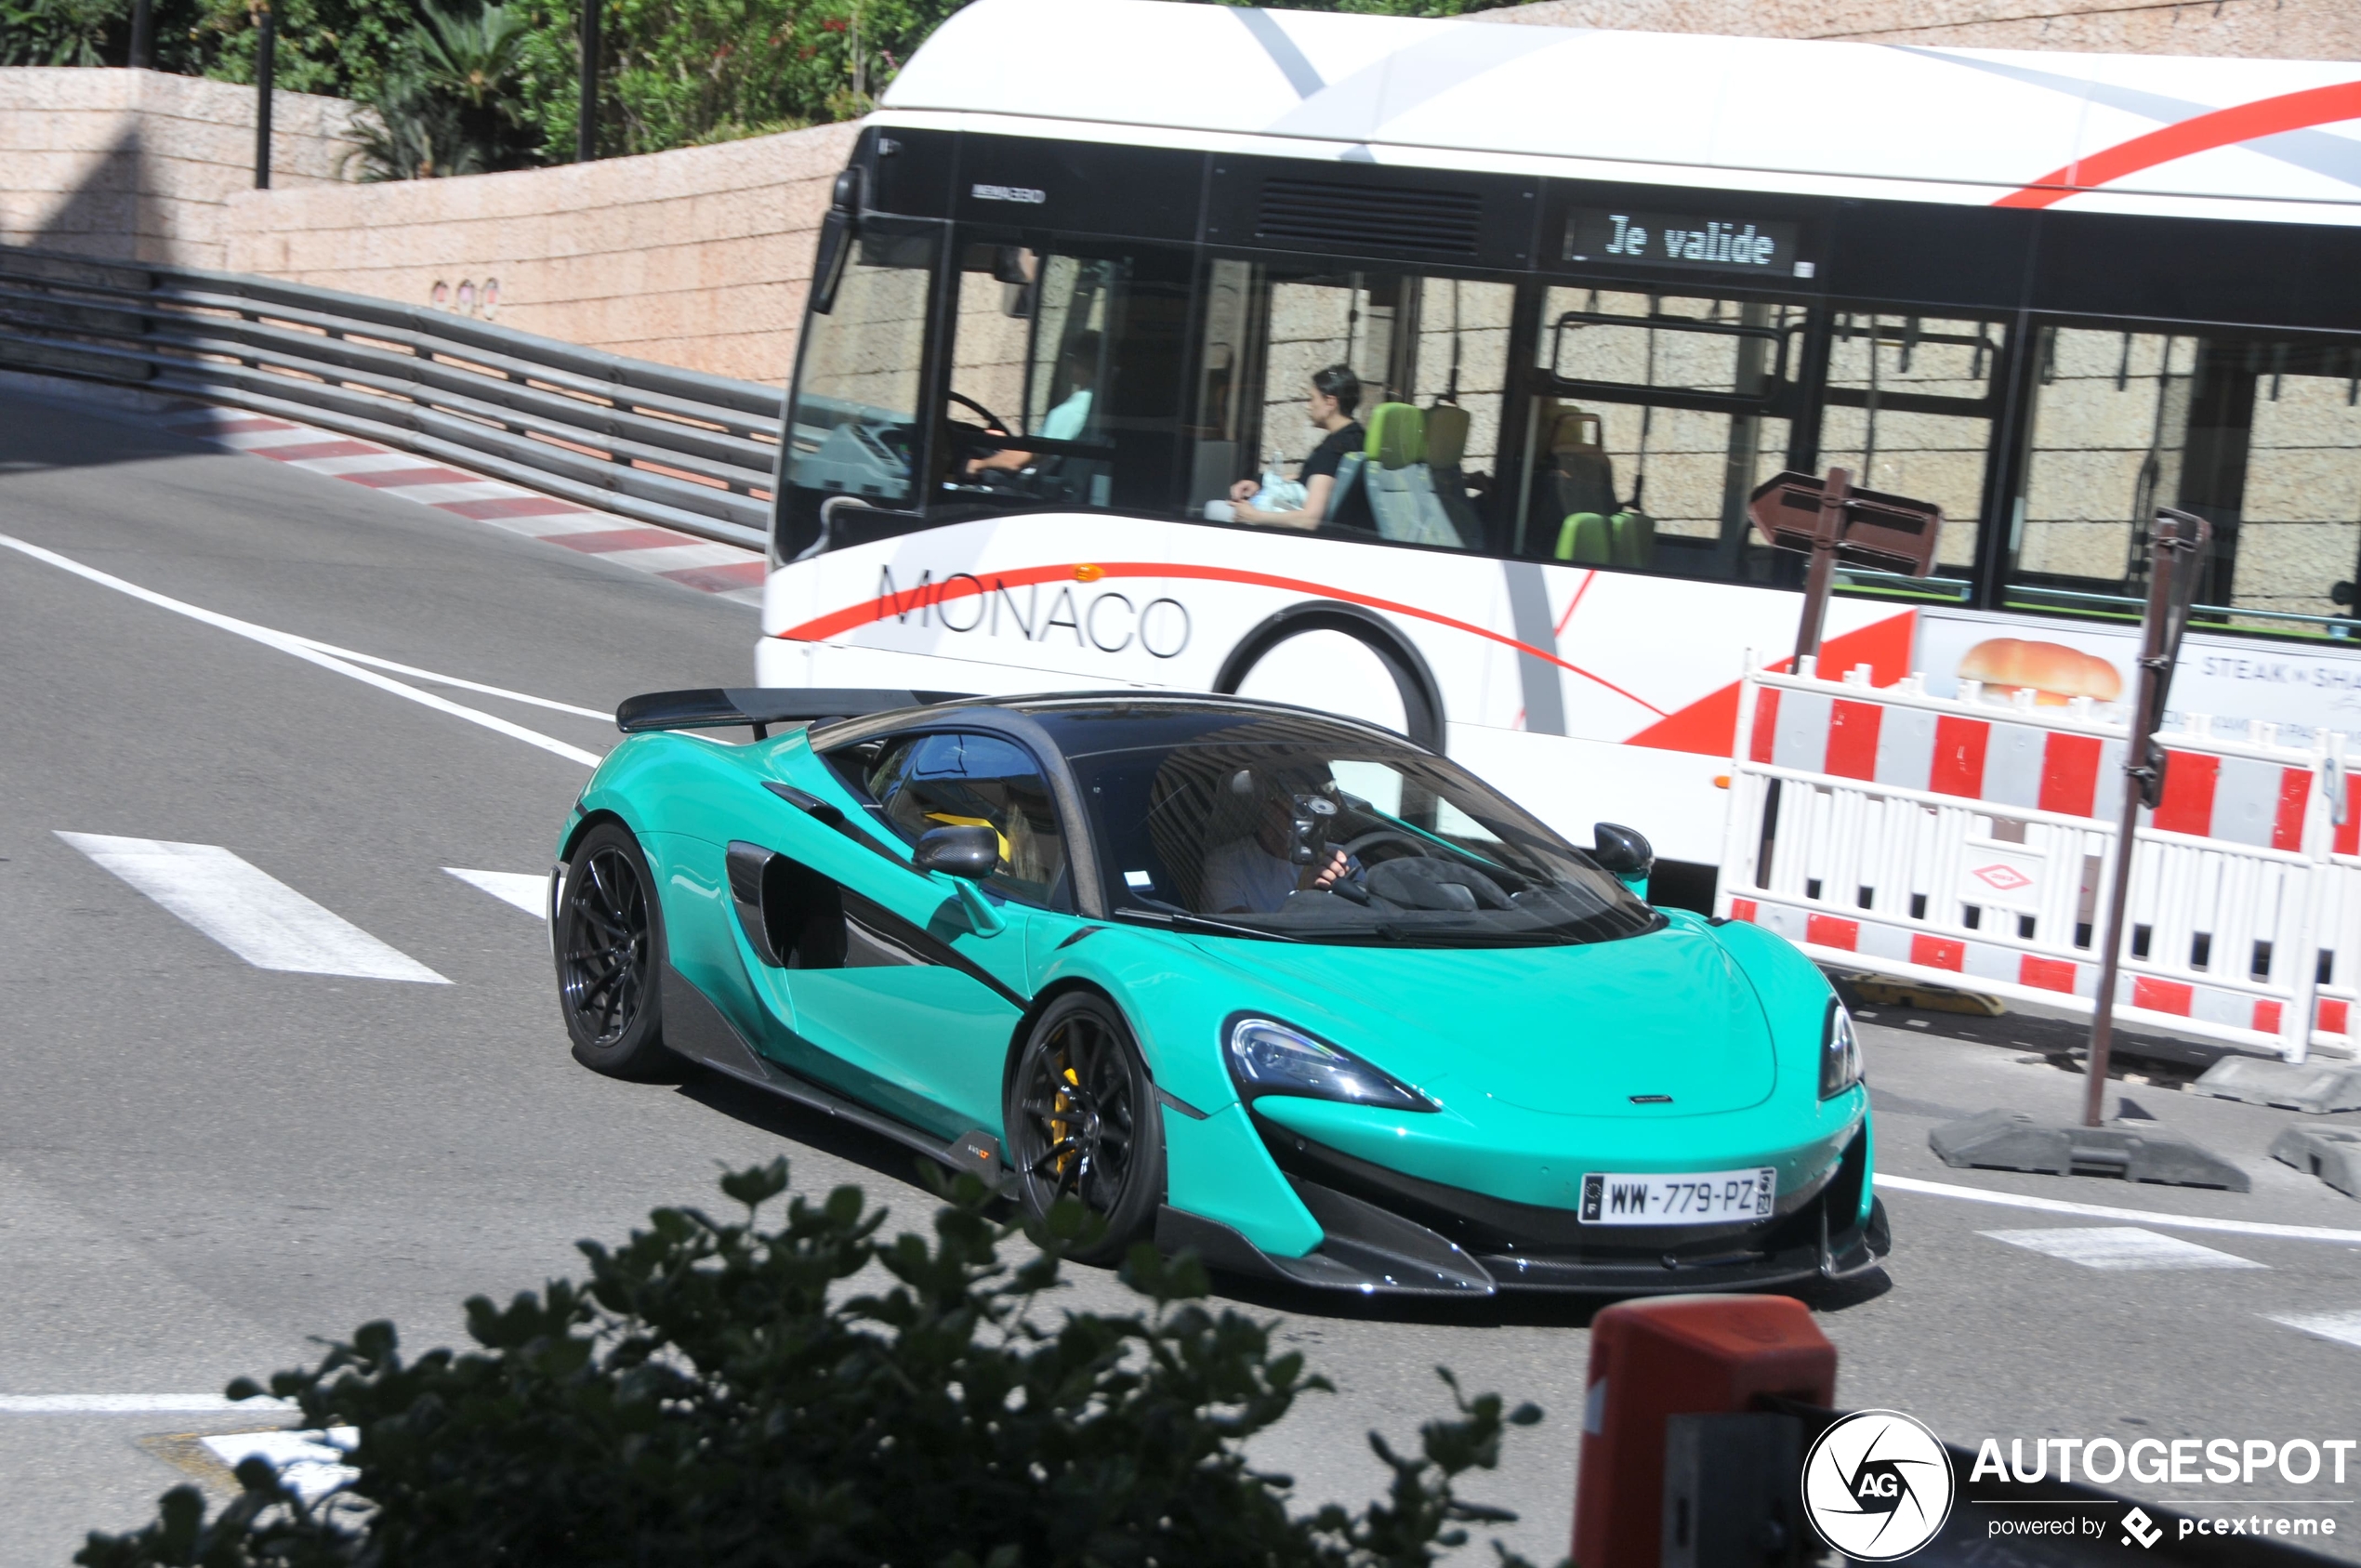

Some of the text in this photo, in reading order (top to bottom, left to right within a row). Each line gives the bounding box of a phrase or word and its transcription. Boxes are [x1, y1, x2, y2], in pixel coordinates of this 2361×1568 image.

[1605, 215, 1774, 265] Je valide
[876, 563, 1192, 659] MONACO
[2200, 655, 2290, 684] STEAK
[1611, 1179, 1754, 1214] WW-779-PZ
